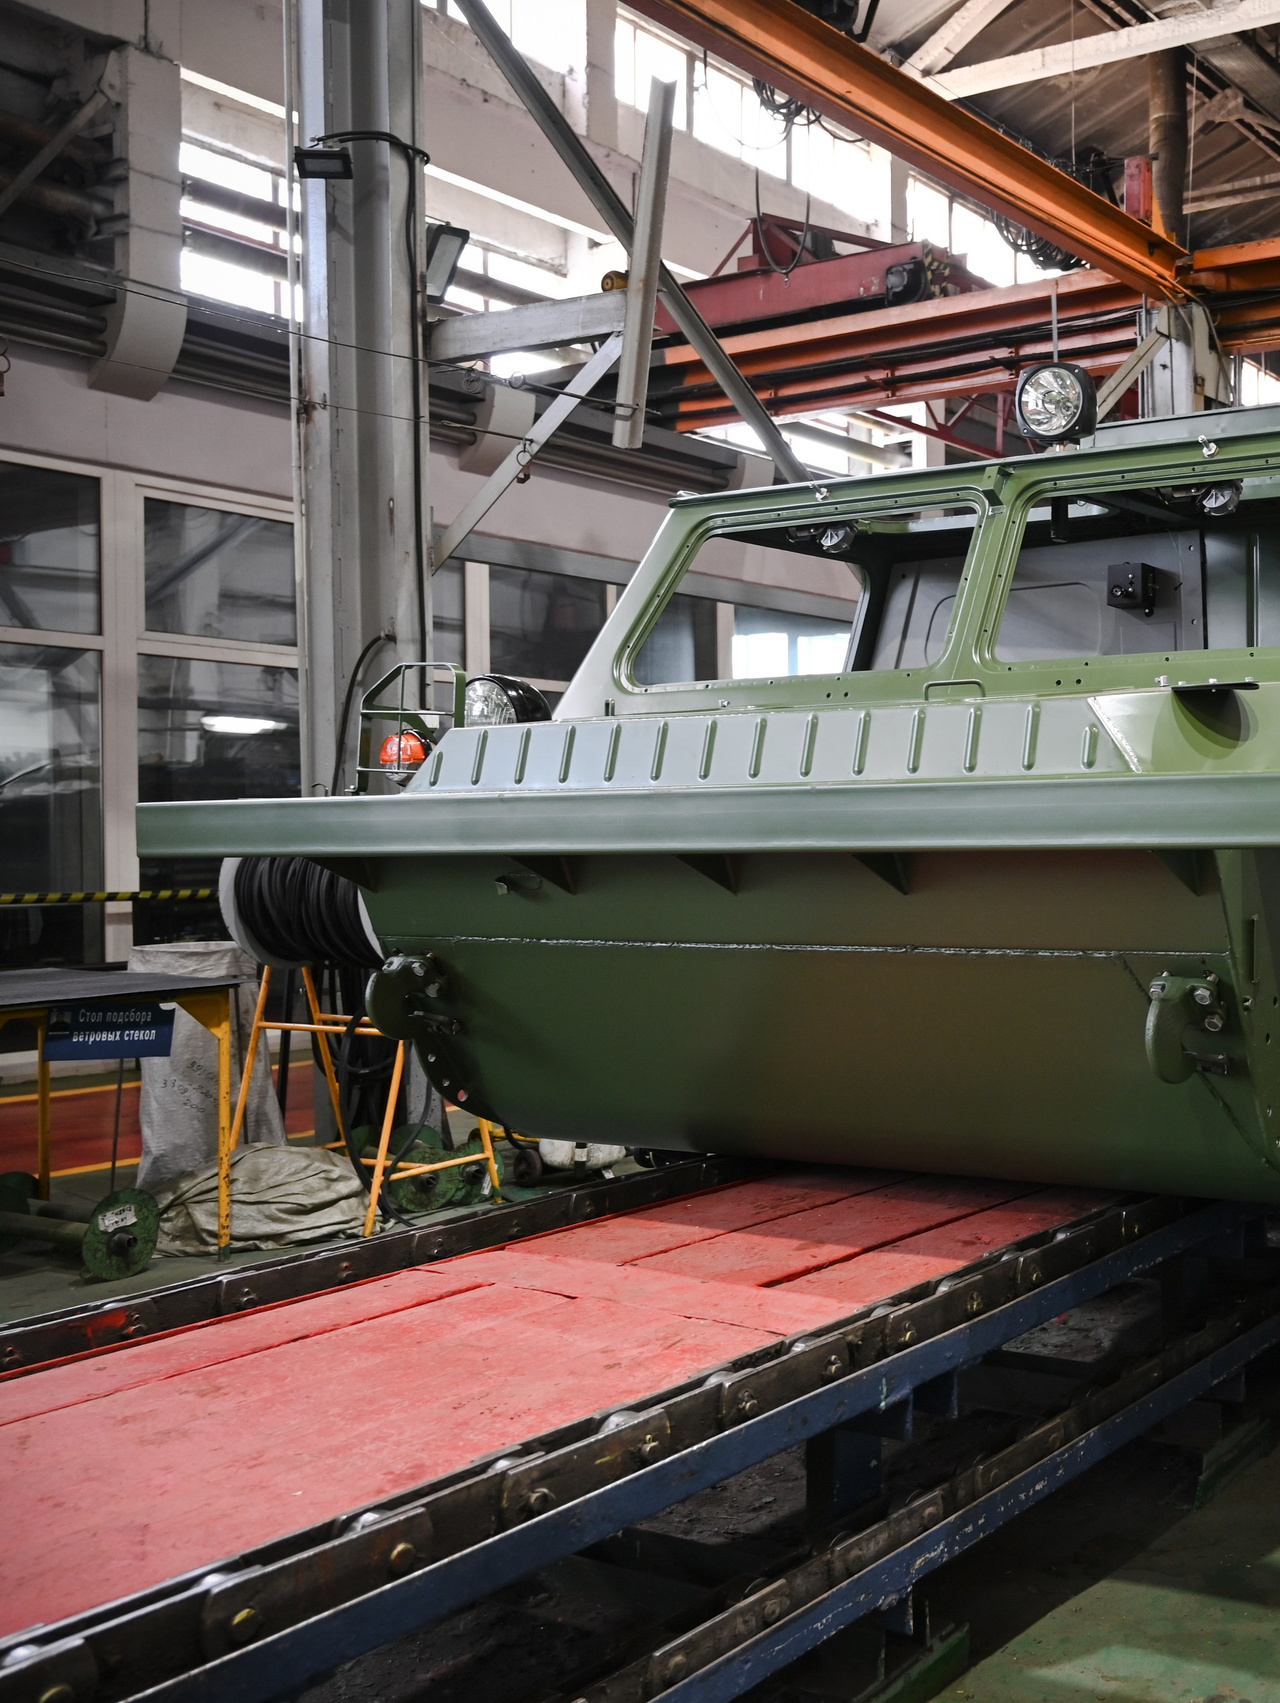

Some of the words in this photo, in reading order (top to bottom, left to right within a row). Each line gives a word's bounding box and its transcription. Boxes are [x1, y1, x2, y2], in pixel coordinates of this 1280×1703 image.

[79, 1008, 103, 1023] Стол
[106, 1008, 152, 1025] подсбора
[72, 1029, 122, 1045] ветровых
[124, 1029, 156, 1041] стекол
